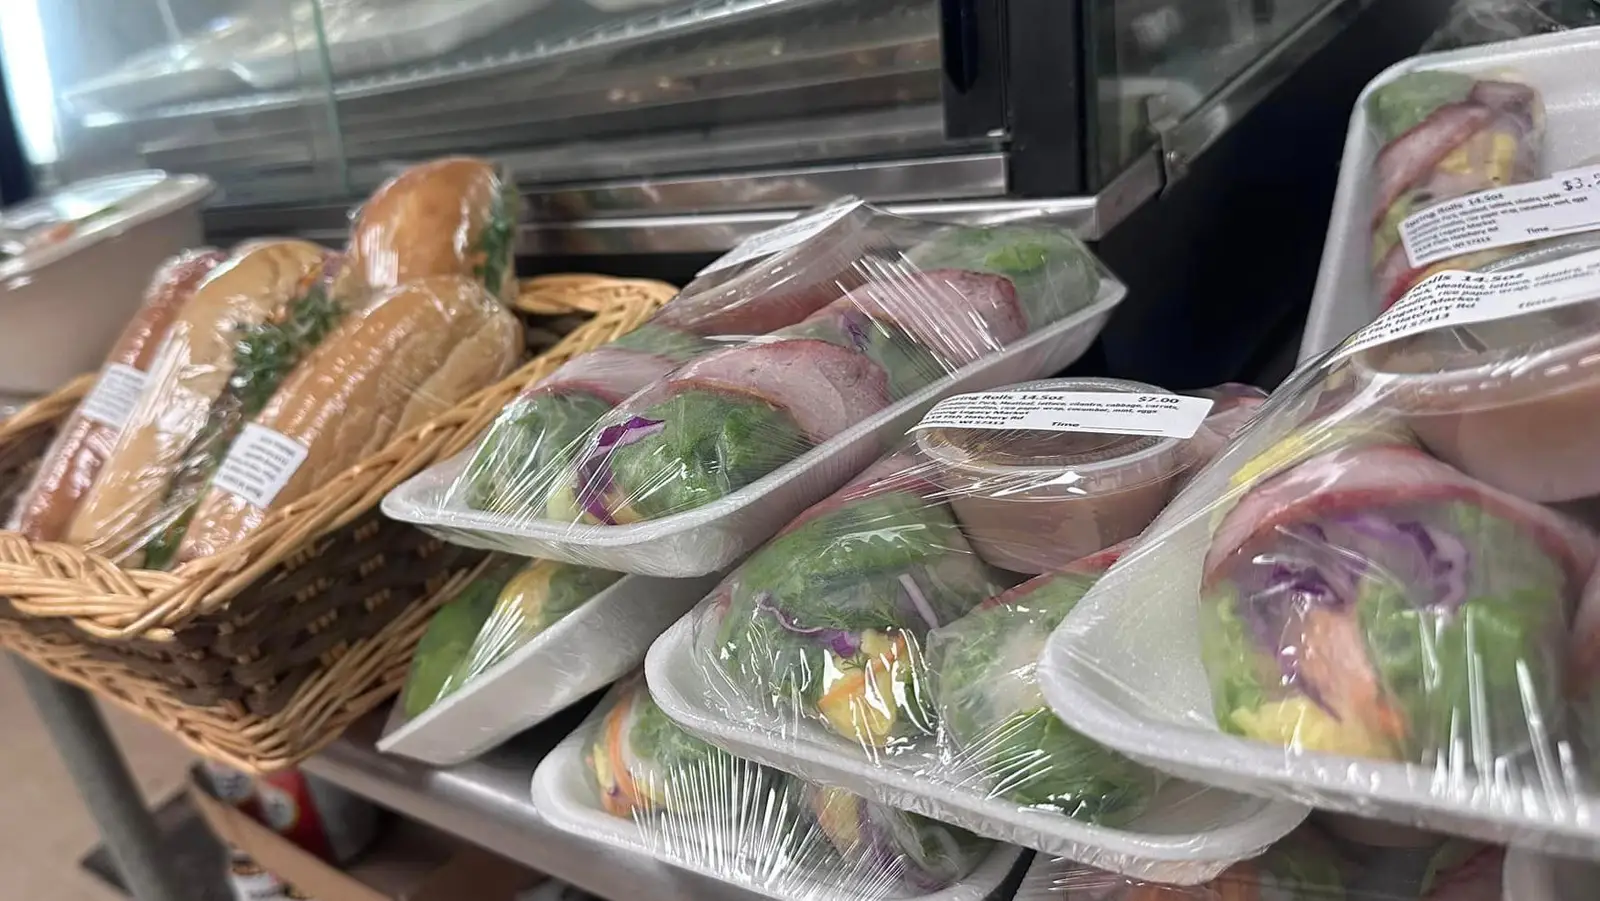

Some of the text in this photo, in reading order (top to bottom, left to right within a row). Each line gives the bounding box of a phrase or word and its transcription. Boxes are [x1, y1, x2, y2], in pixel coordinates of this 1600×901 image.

[1437, 203, 1463, 214] Rolls
[1527, 226, 1549, 235] Time
[1462, 272, 1524, 284] 14.5oz
[1430, 296, 1480, 306] Market
[1138, 396, 1181, 404] $7.00
[1104, 402, 1143, 410] cabbage,
